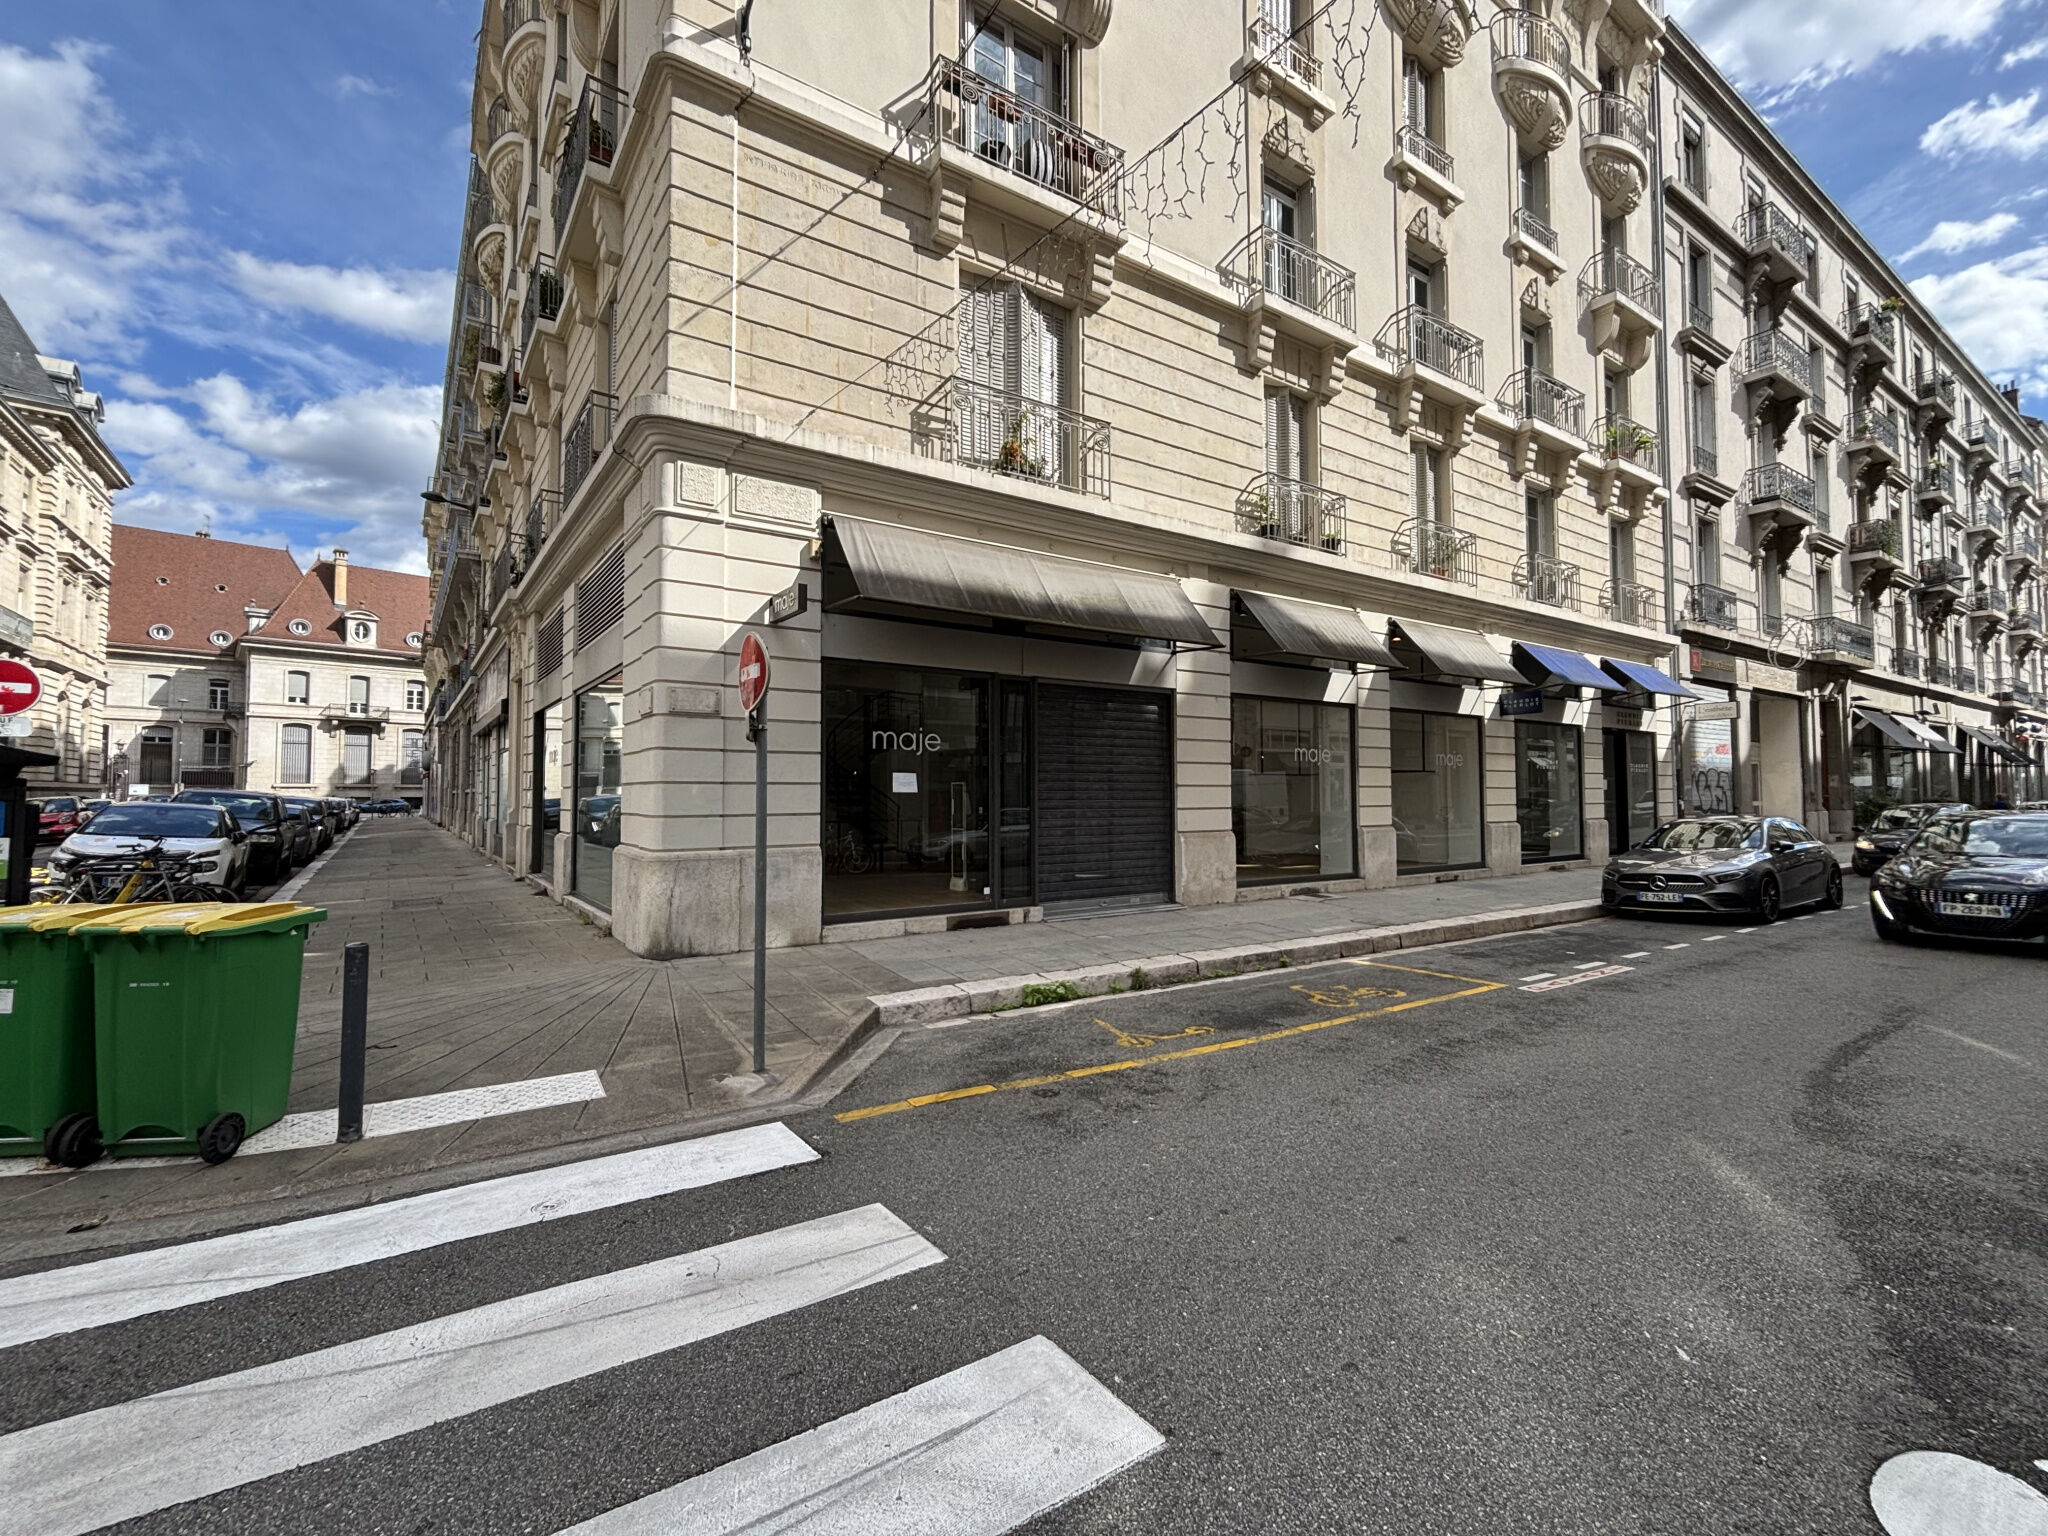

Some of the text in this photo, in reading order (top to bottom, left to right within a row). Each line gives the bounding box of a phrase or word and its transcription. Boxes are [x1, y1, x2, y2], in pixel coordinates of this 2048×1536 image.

[774, 590, 795, 613] maje
[873, 727, 941, 755] maje
[1295, 745, 1331, 766] maje
[1436, 751, 1464, 768] maje
